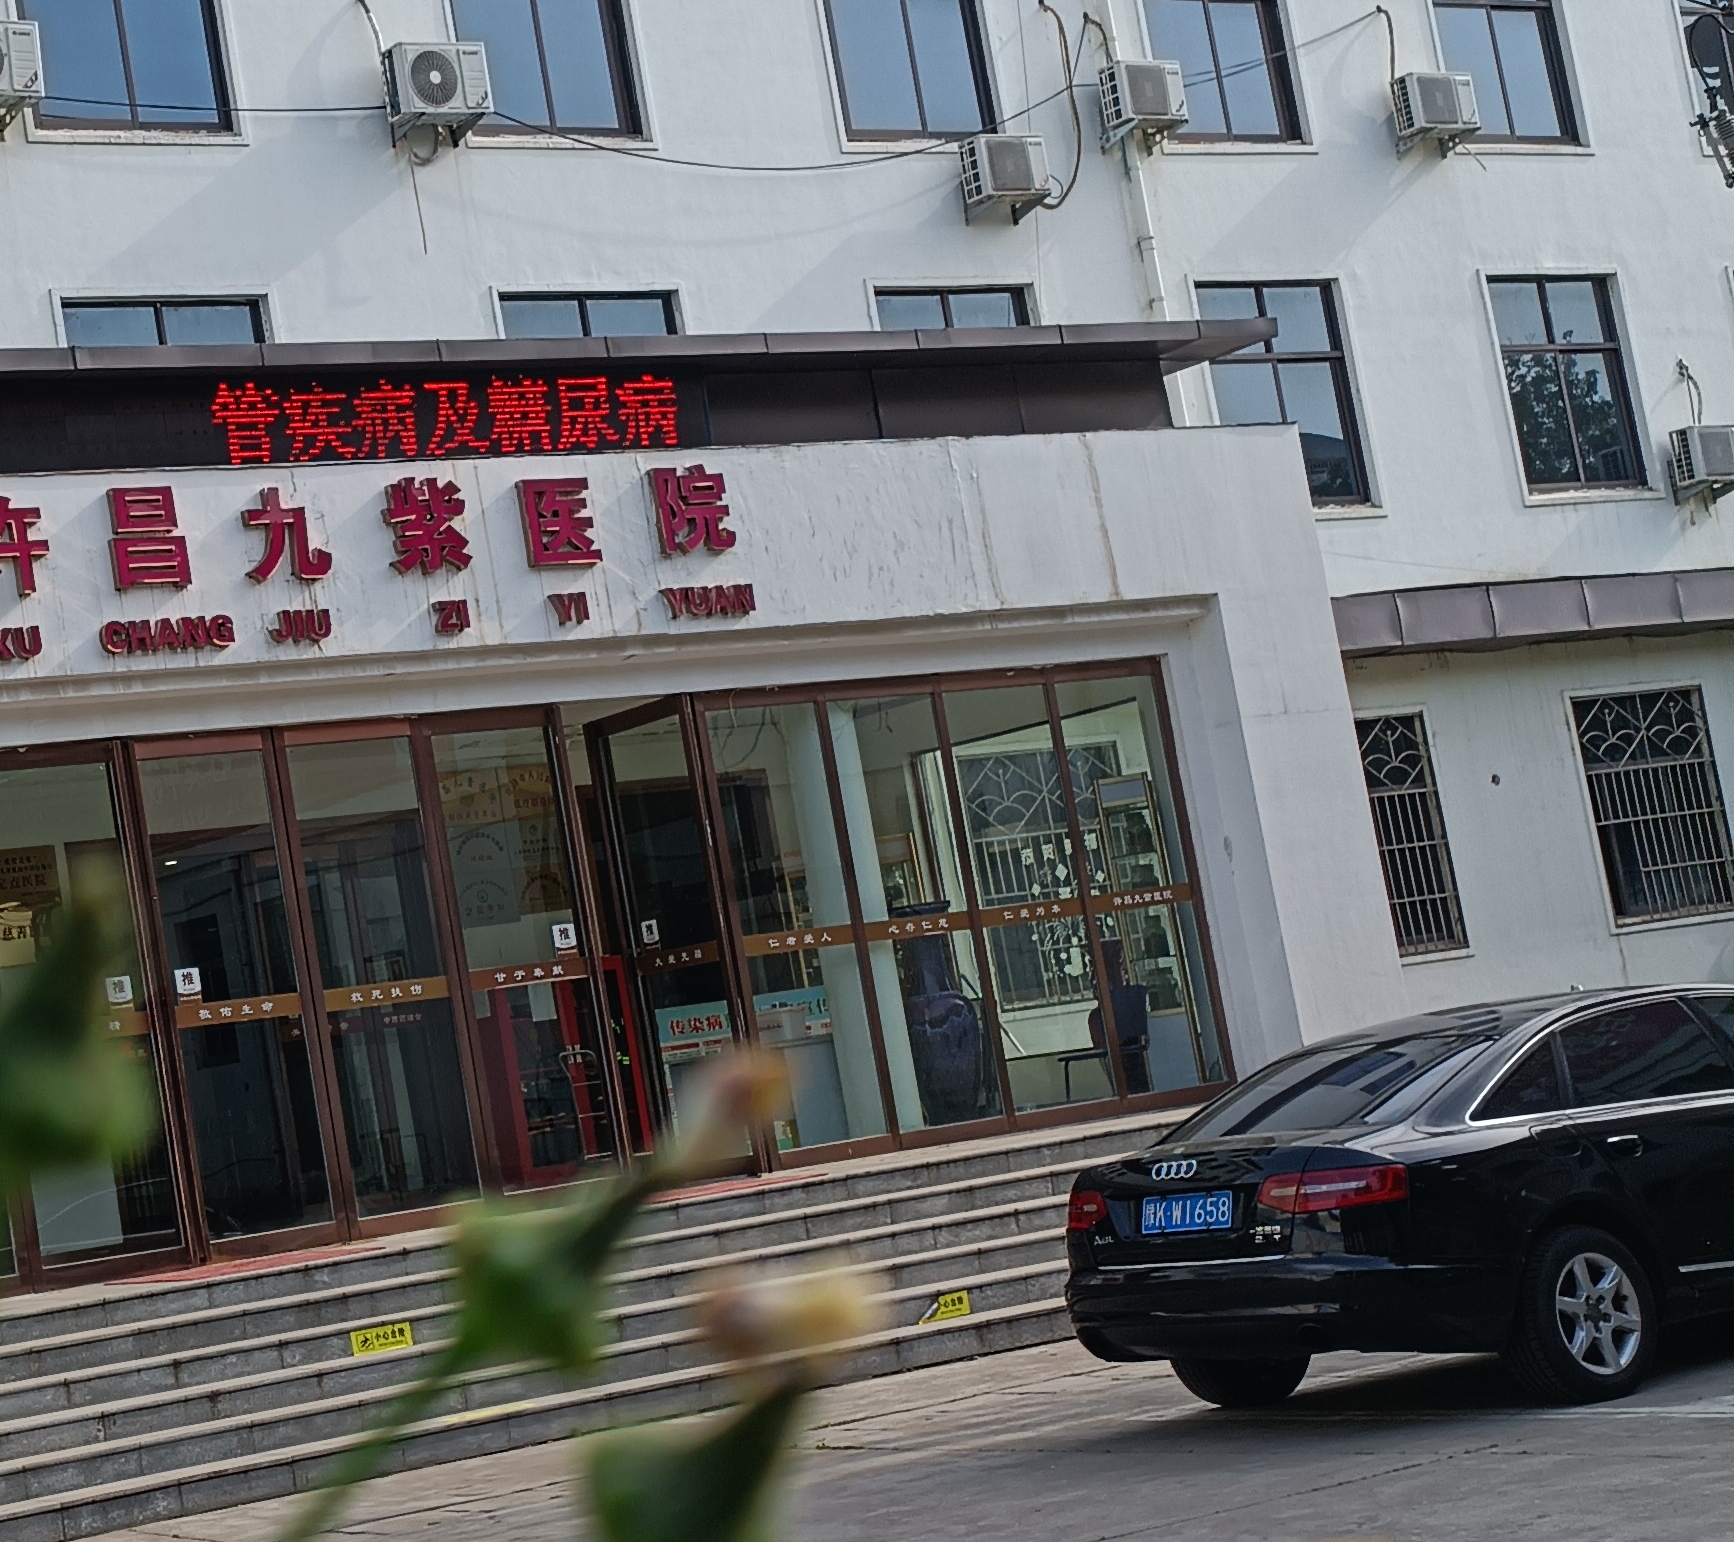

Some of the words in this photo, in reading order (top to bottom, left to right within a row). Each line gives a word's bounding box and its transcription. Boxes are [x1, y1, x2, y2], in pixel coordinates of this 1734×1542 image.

[210, 374, 679, 465] 管疾病及糖尿病
[100, 612, 236, 655] CHANG
[269, 608, 333, 644] JIU
[432, 599, 471, 635] ZI
[547, 591, 586, 626] YI
[661, 583, 756, 620] YUAN
[181, 971, 195, 987] 推
